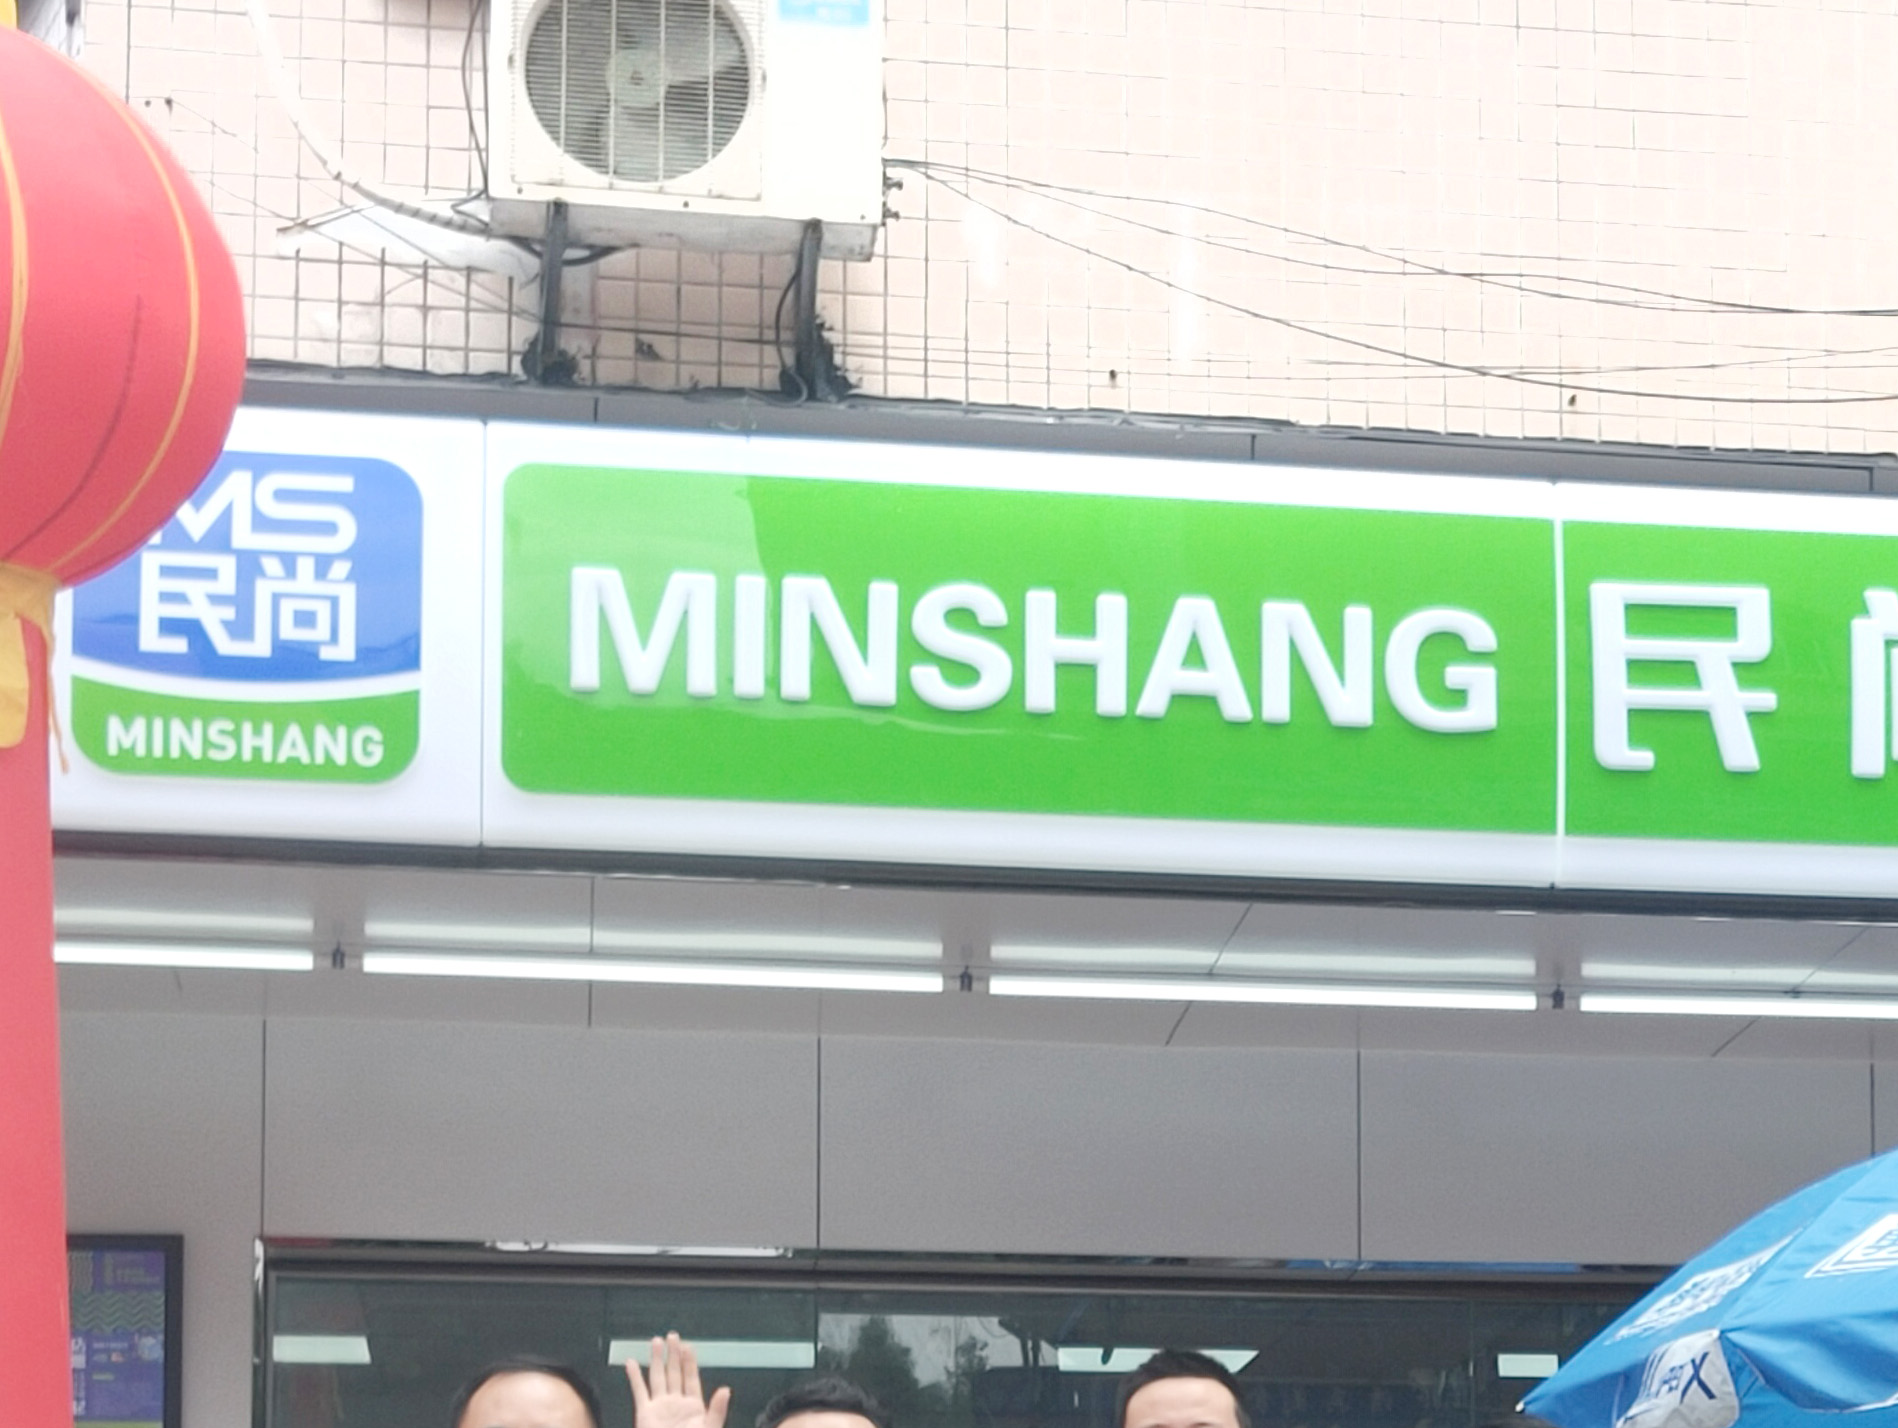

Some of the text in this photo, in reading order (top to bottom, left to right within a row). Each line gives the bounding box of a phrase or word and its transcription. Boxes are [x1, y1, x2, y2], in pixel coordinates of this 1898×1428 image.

[139, 551, 357, 662] 民尚
[568, 565, 1499, 734] MINSHANG
[105, 713, 386, 768] MINSHANG
